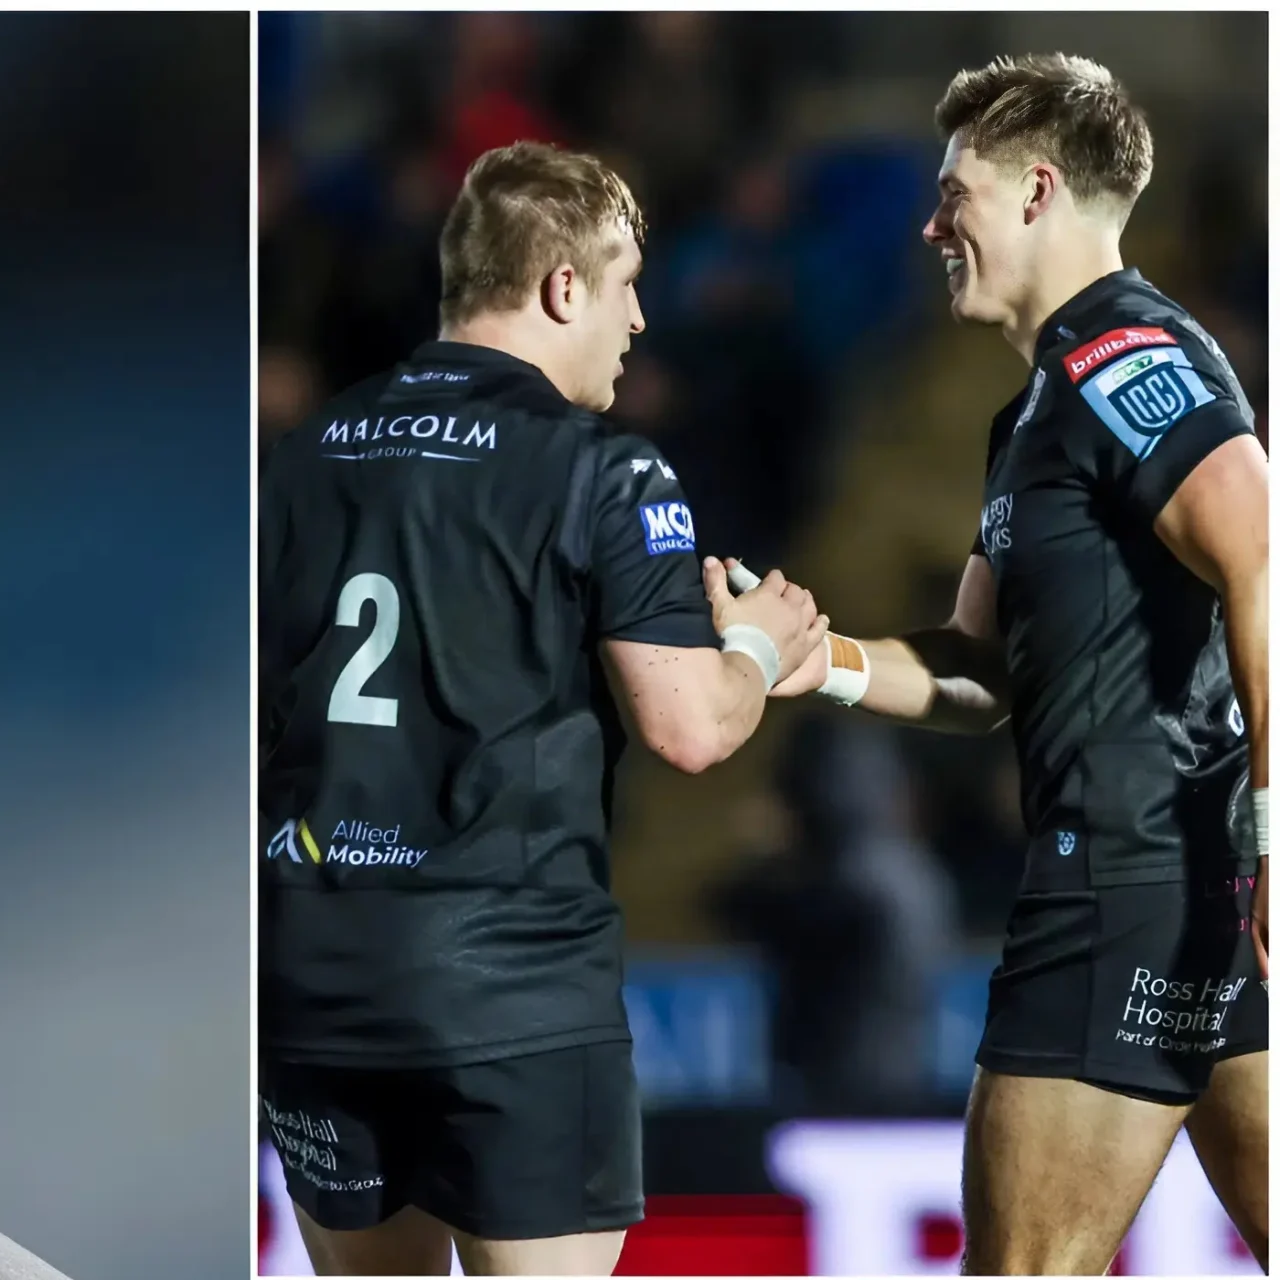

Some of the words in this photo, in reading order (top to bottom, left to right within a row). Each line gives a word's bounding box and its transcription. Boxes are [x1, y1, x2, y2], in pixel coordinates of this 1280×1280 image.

[321, 415, 496, 449] MALCOLM
[327, 573, 400, 725] 2
[332, 820, 400, 844] Allied
[326, 845, 428, 868] Mobility
[1131, 967, 1195, 1000] Ross
[1200, 977, 1247, 1002] Hall
[1123, 996, 1227, 1034] Hospital
